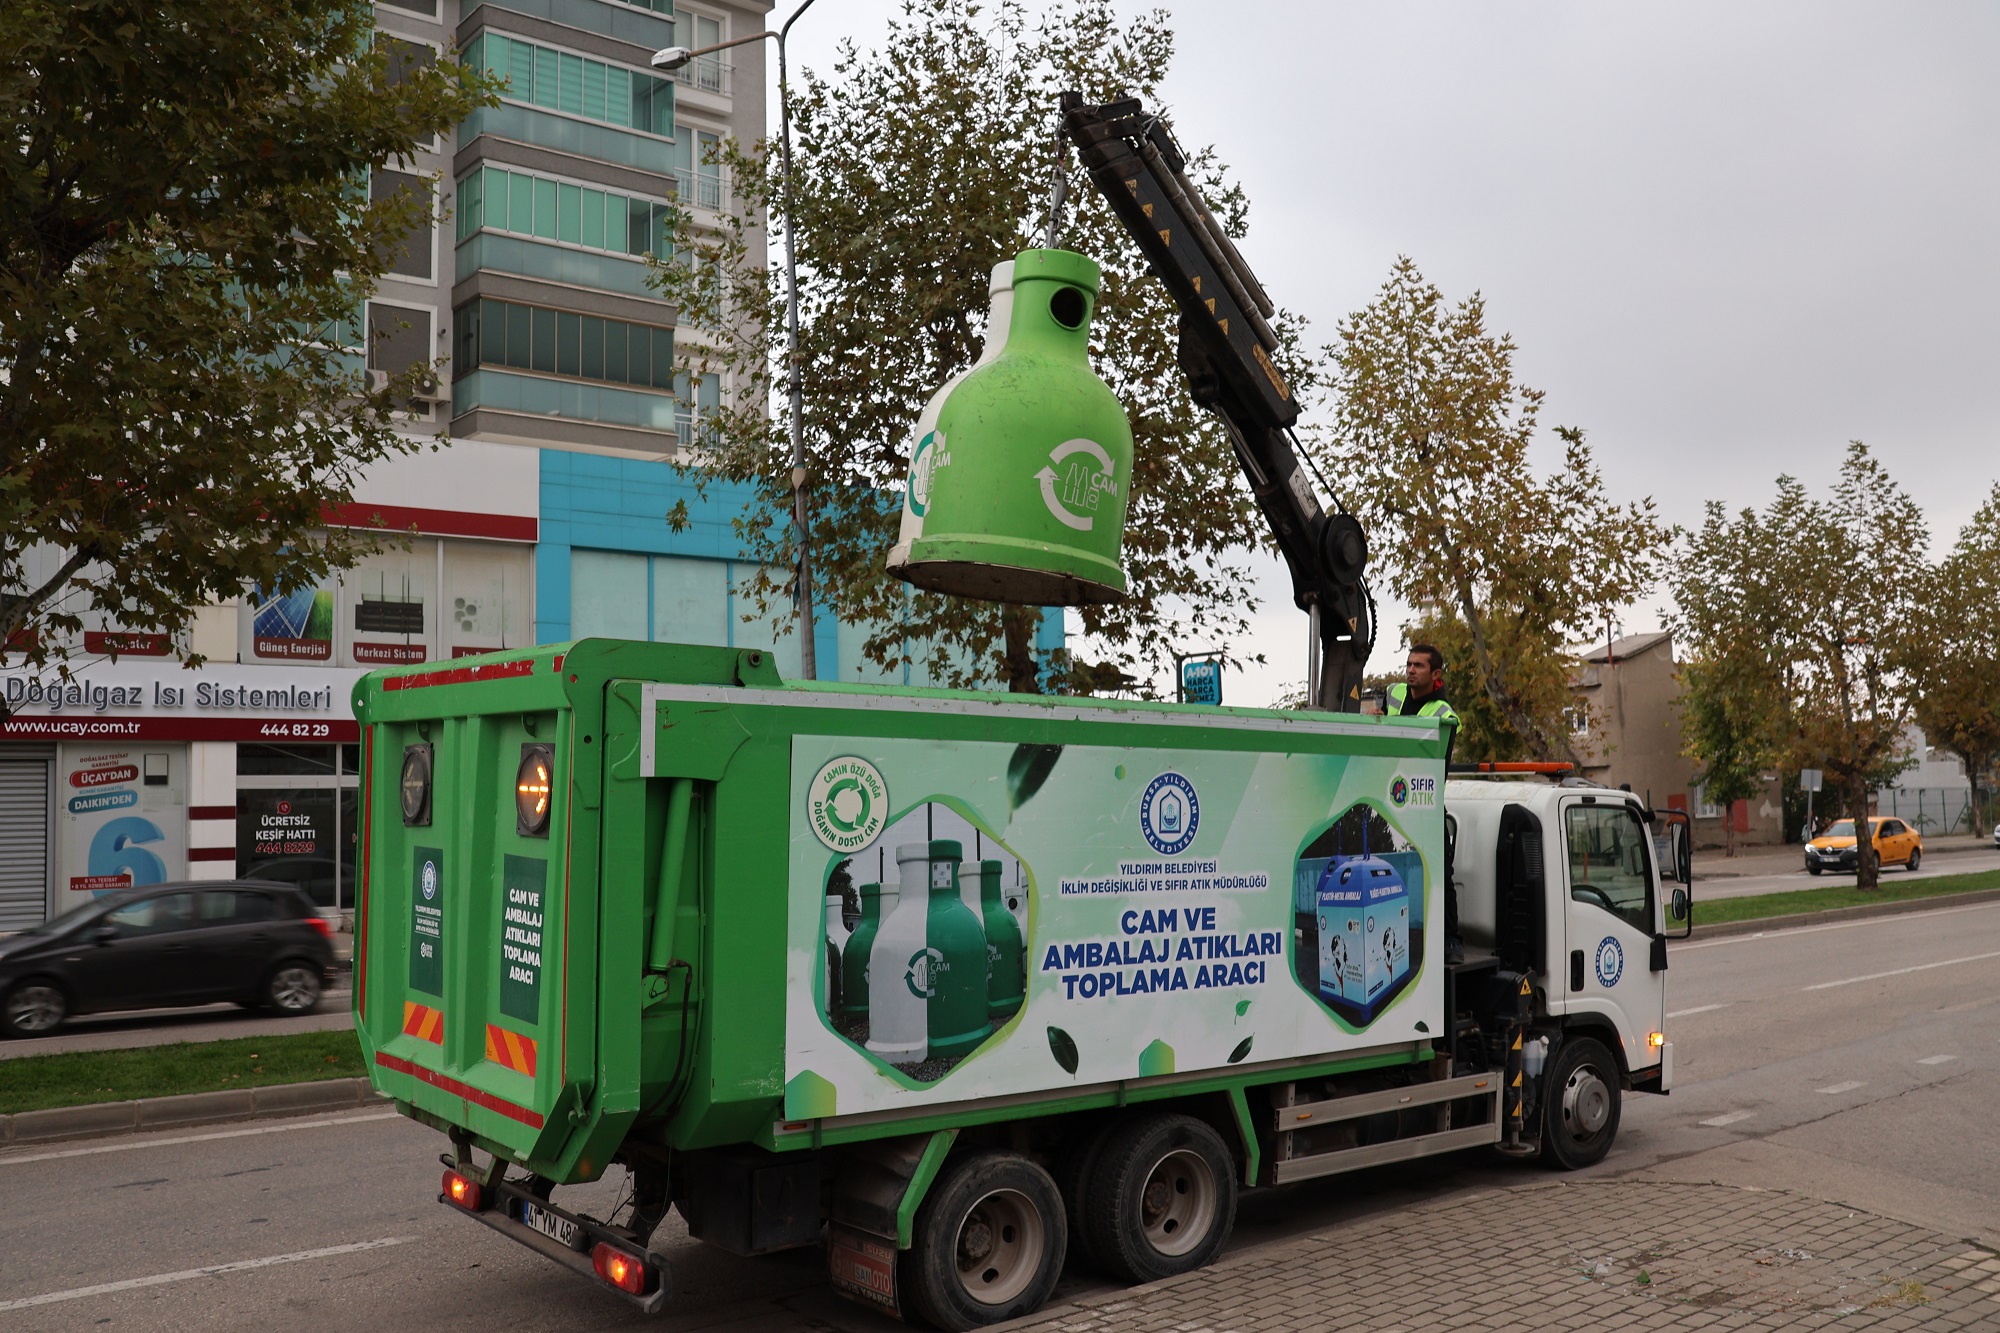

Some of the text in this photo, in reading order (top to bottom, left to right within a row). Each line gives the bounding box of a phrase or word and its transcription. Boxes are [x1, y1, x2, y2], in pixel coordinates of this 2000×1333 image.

[931, 450, 951, 471] CAM
[1090, 472, 1118, 498] CAM
[259, 641, 326, 657] Güneş Enerjisi
[356, 646, 424, 660] Merkezi Sistem
[6, 677, 331, 712] Doğalgaz Isı Sistemleri
[4, 721, 330, 737] www.ucay.com.tr 444 82 29
[81, 769, 131, 784] ÜÇAY'DAN
[823, 762, 881, 799] CAMIN ÖZÜ DOĞA
[1411, 778, 1434, 791] SIFIR
[75, 795, 132, 810] DAIKIN'DEN
[1142, 775, 1197, 818] BURSA YILDIRIM
[1411, 792, 1434, 805] ATIK
[261, 814, 310, 826] ÜCRETSİZ
[814, 801, 879, 847] DOĞANIN DOSTU CAM
[255, 829, 316, 841] KEŞİF HATTI
[256, 842, 315, 854] 444 8229
[1120, 860, 1217, 875] YILDIRIM BELEDİYESİ
[1061, 875, 1267, 894] İKLİM DEĞİŞİKLİĞİ VE SIFIR ATIK MÜDÜRLÜĞÜ
[509, 888, 539, 907] CAM VE
[505, 907, 542, 928] AMBALAJ
[1121, 907, 1216, 935] CAM VE
[505, 926, 541, 947] ATIKLARI
[504, 945, 541, 967] TOPLAMA
[1042, 932, 1282, 971] AMBALAJ ATIKLARI
[509, 965, 533, 985] ARACI
[930, 963, 950, 973] CAM
[1062, 960, 1266, 1000] TOPLAMA ARACI
[542, 1210, 557, 1238] YM
[560, 1220, 577, 1245] 48
[873, 1270, 890, 1293] OTO
